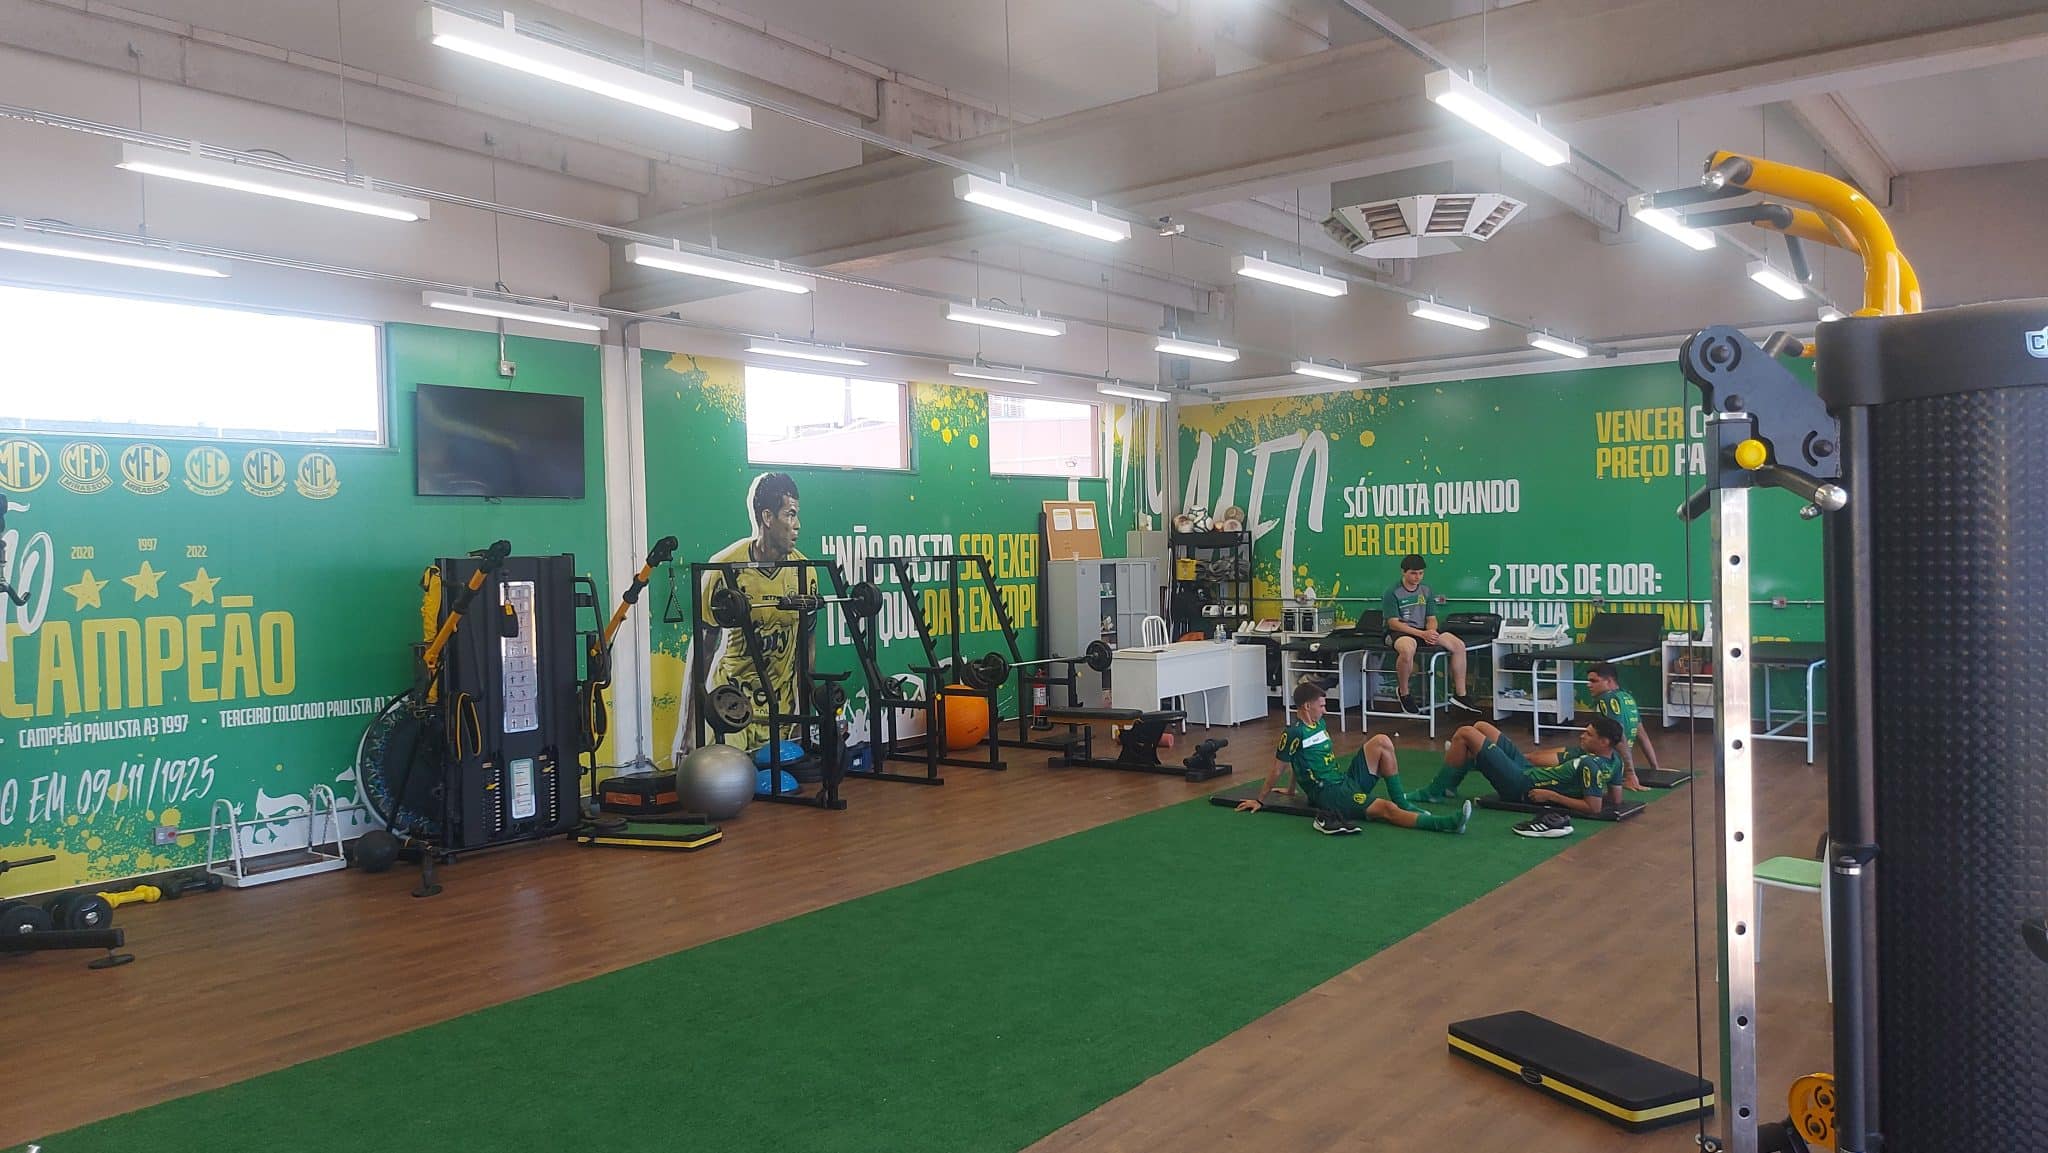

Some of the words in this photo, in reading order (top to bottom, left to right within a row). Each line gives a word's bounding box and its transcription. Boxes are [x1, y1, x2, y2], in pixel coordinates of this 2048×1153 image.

[1595, 406, 1684, 443] VENCER
[65, 444, 101, 479] MFC
[125, 446, 164, 482] MFC
[189, 449, 224, 484] MFC
[247, 451, 280, 484] MFC
[301, 455, 332, 486] MFC
[1596, 444, 1669, 483] PREÇO
[1675, 443, 1706, 476] PA
[62, 477, 108, 492] MIRASSOL
[124, 480, 169, 494] MIRASSOL
[1343, 477, 1368, 518] SÓ
[1373, 483, 1430, 517] VOLTA
[1434, 479, 1520, 519] QUANDO
[71, 546, 94, 560] 2020
[137, 538, 158, 551] 1997
[186, 545, 208, 558] 2022
[1343, 524, 1380, 556] DER
[1384, 522, 1449, 555] CERTO!
[888, 534, 954, 583] BASTA
[959, 533, 994, 580] SER
[1488, 564, 1501, 594] 2
[1506, 564, 1568, 595] TIPOS
[1574, 564, 1601, 594] DE
[1607, 563, 1662, 595] DOR:
[969, 583, 1040, 633] EXEMPL
[0, 595, 296, 719] CAMPEÃO
[219, 707, 271, 728] TERCEIRO
[272, 702, 325, 723] COLOCADO
[327, 698, 372, 717] PAULISTA
[19, 722, 82, 749] CAMPEÃO
[84, 719, 141, 743] PAULISTA
[143, 717, 158, 736] A3
[161, 714, 189, 733] 1997
[28, 772, 67, 824] EM
[77, 754, 218, 817] 09/11/1925
